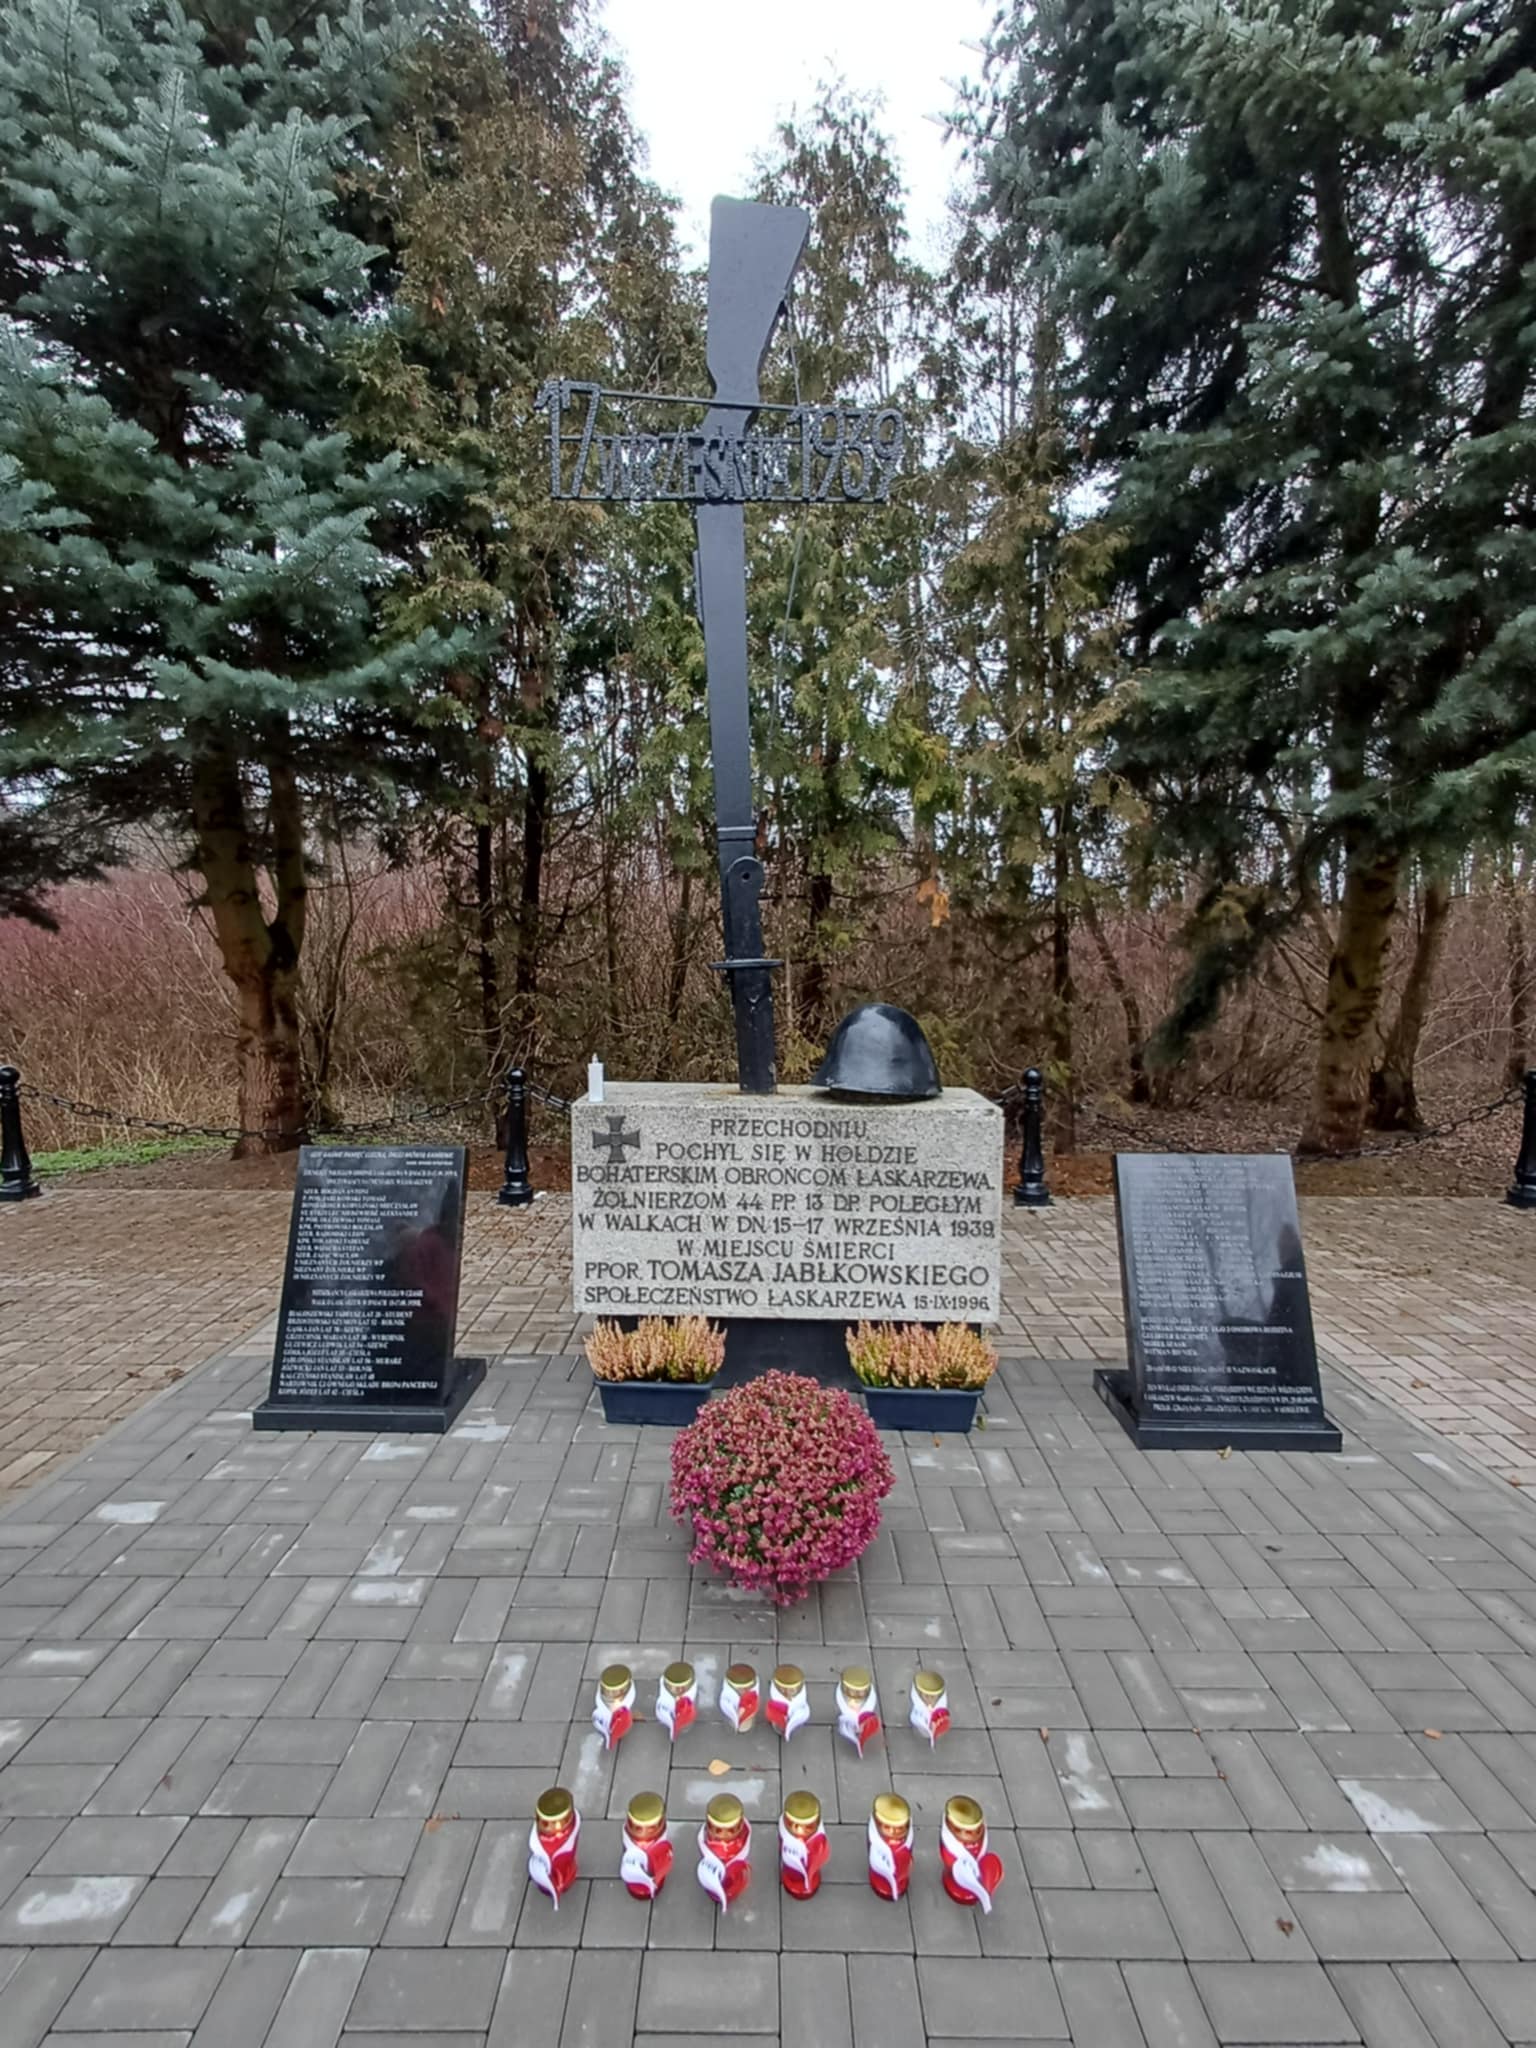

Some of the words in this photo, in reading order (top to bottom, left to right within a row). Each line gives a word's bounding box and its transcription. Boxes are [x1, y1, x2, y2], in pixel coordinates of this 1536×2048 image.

[533, 380, 600, 498] 17
[786, 403, 903, 500] 1939
[655, 1142, 744, 1161] POCHYL
[751, 1143, 787, 1164] SIĘ
[795, 1144, 812, 1161] W
[576, 1165, 718, 1184] BOHATERSKIM
[724, 1166, 848, 1186] OBROŃCOM
[593, 1187, 727, 1209] ŻOŁNIERZOM
[736, 1193, 764, 1210] 44
[806, 1193, 824, 1211] 13
[869, 1194, 982, 1214] POLEGŁYM
[578, 1213, 595, 1230] W
[605, 1213, 701, 1233] WALKACH
[711, 1215, 729, 1232] W
[834, 1217, 941, 1237] WRZEŚNIA
[677, 1239, 694, 1256] W
[703, 1239, 794, 1258] MIEJSCU
[803, 1239, 895, 1260] ŚMIERCI
[647, 1259, 765, 1282] TOMASZA
[772, 1261, 990, 1287] JABŁKOWSKIEGO
[584, 1285, 758, 1306] SPOŁECZEŃSTWO
[768, 1288, 906, 1309] ŁASKARZEWA
